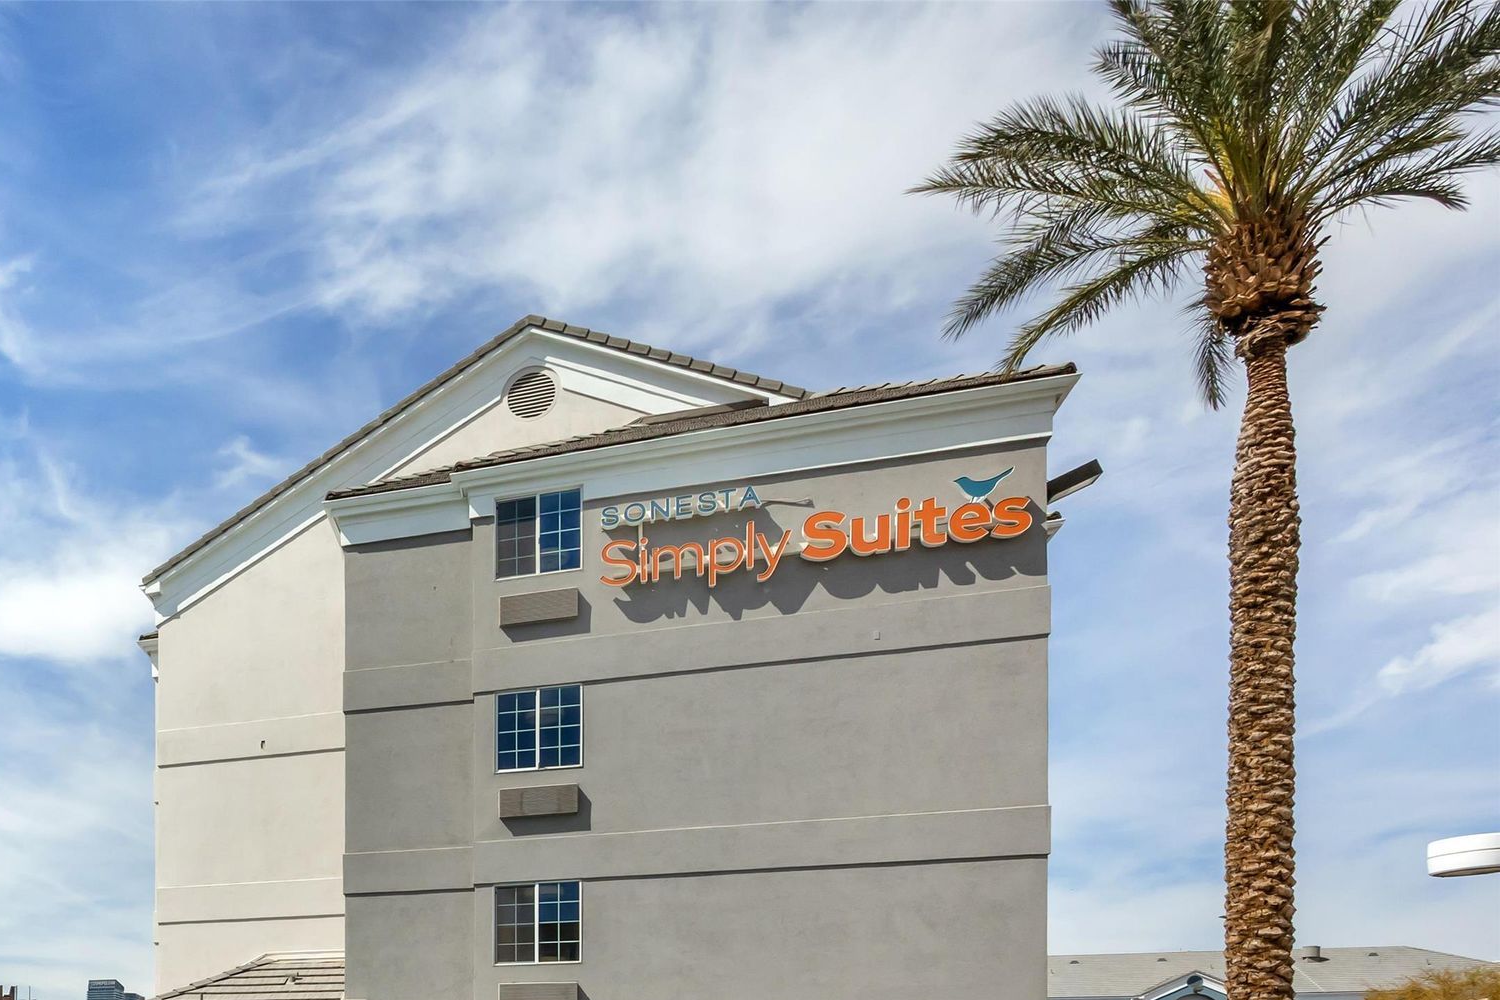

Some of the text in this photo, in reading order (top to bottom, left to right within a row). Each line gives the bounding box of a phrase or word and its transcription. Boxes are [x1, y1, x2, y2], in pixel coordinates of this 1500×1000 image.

[601, 485, 762, 530] SONESTA
[600, 496, 1033, 588] Simply Suites
